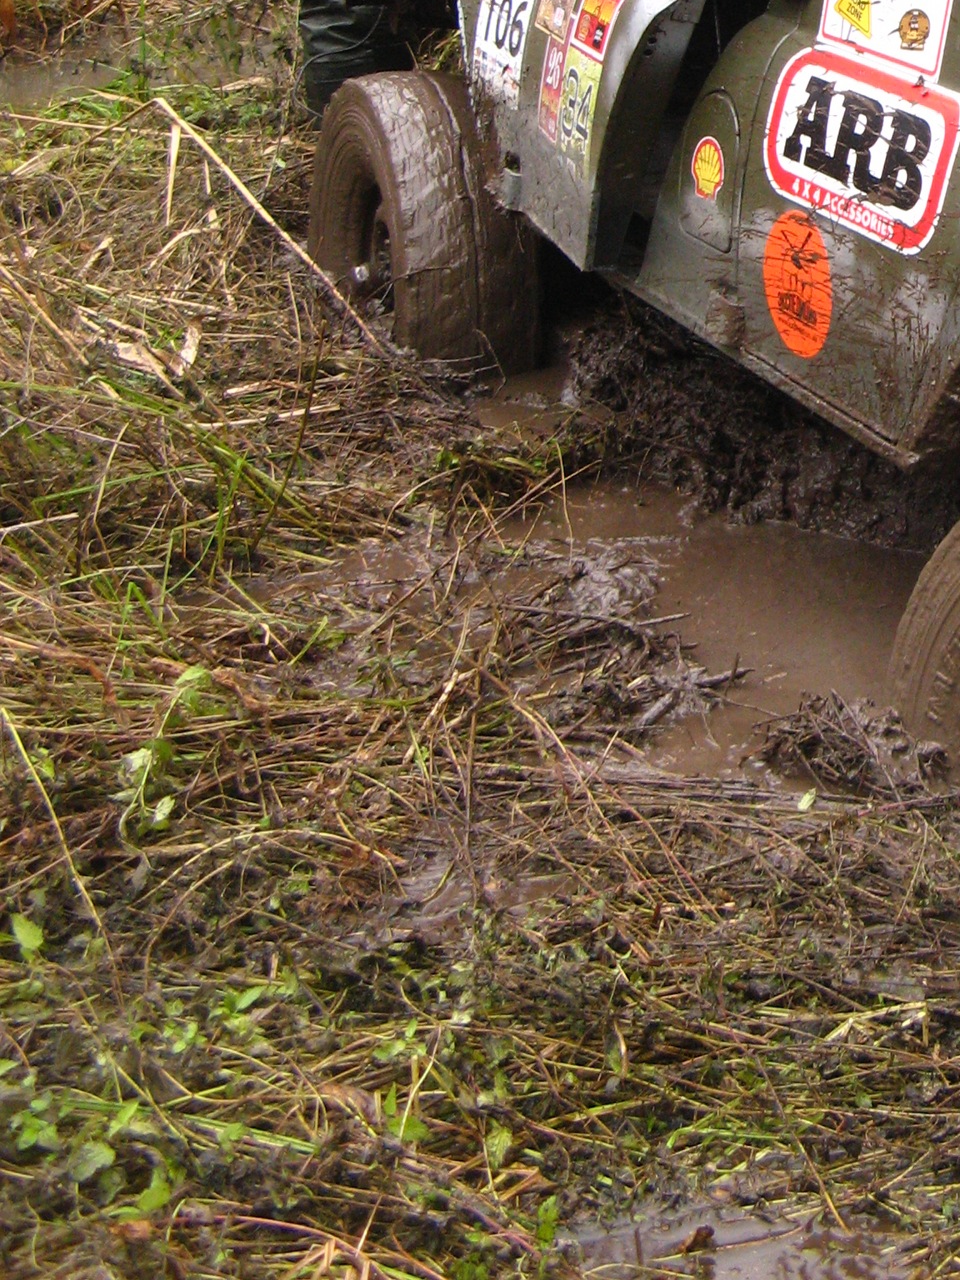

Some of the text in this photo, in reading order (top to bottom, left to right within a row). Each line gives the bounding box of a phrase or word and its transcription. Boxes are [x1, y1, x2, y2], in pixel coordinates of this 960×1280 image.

[846, 3, 863, 21] ZONE
[783, 75, 932, 211] ARB
[823, 192, 895, 238] ACCESSORIES
